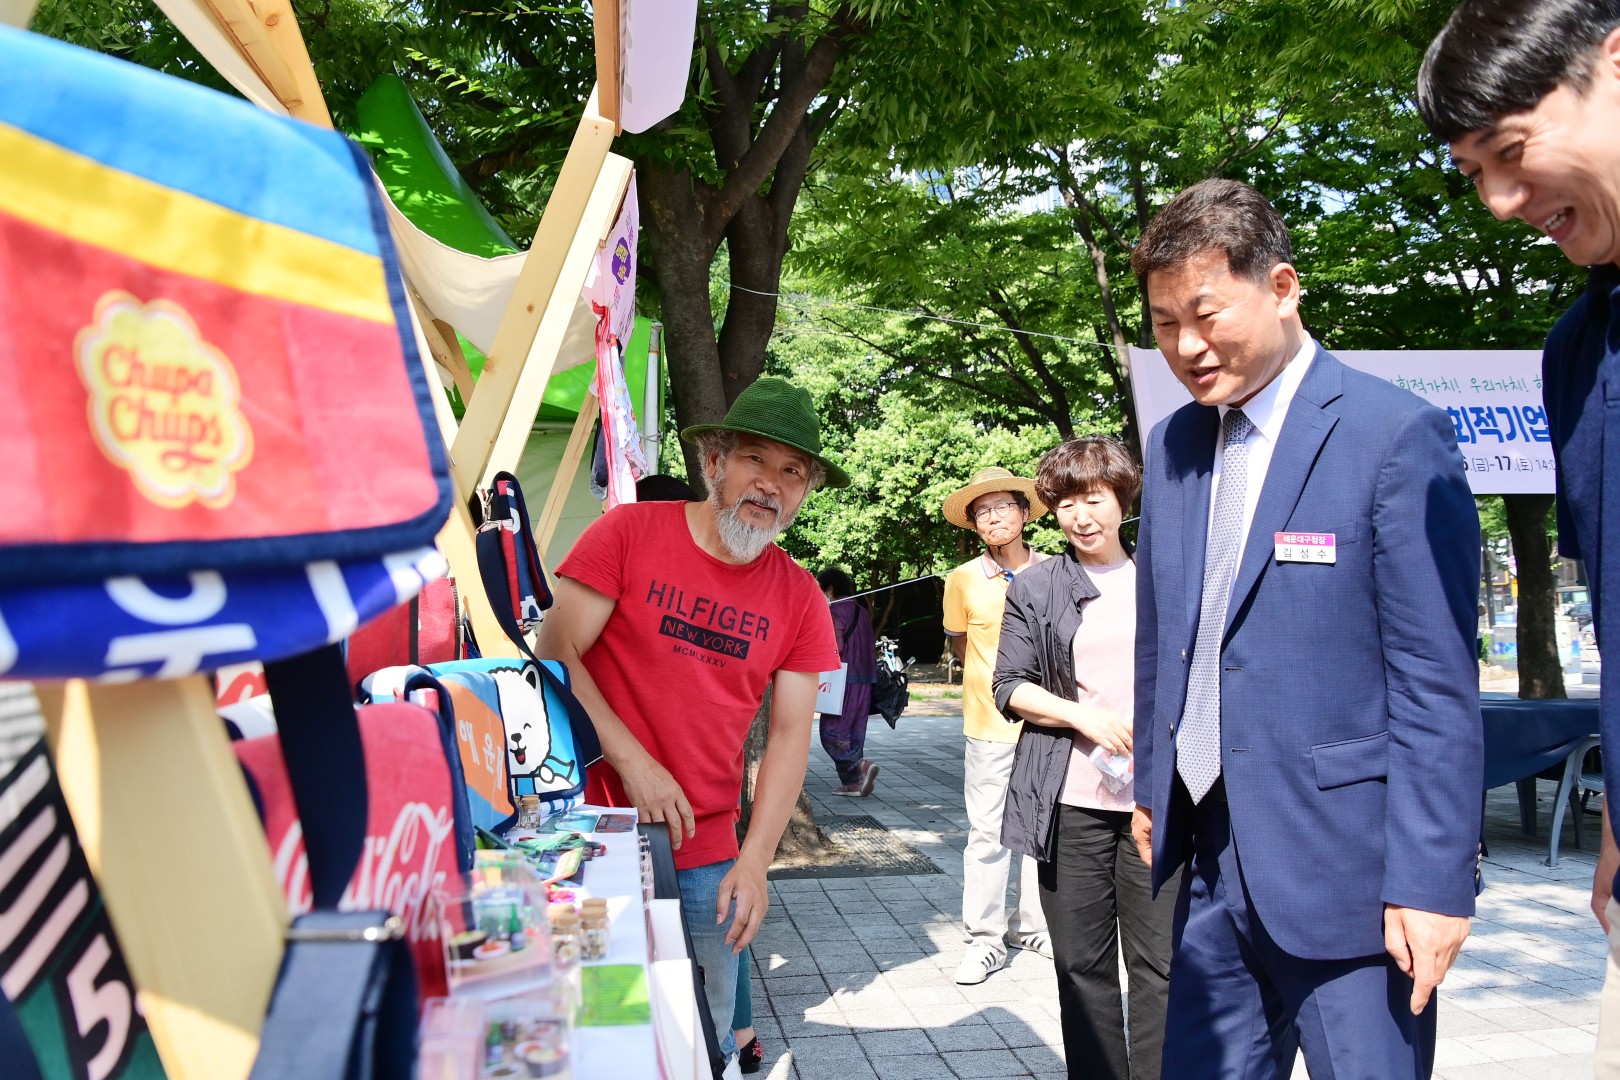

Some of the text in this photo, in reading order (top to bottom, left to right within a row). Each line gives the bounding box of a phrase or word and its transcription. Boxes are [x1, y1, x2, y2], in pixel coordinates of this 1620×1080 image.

[102, 344, 214, 406] Chupa
[1390, 374, 1461, 394] 회적가치!
[1470, 375, 1529, 393] 우리가치!
[109, 394, 222, 472] Chups
[1282, 534, 1326, 545] 해운대구청장
[646, 579, 770, 641] HILFIGER
[664, 619, 747, 657] NEW YORK
[672, 644, 727, 668] MCMLXXXV
